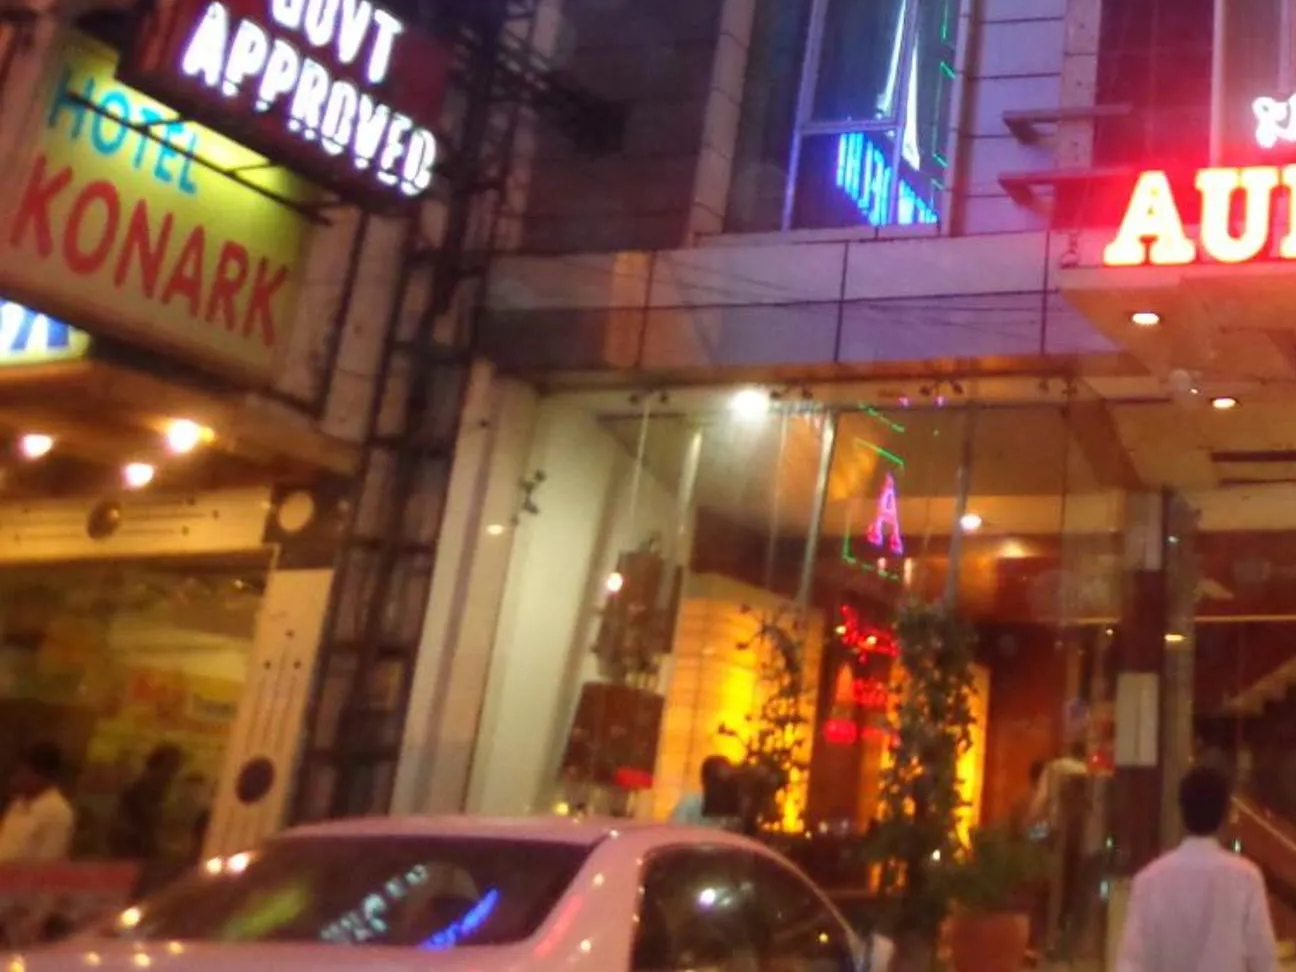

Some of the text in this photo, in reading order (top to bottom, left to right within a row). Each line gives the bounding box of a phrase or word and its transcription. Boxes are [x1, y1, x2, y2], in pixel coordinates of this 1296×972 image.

[47, 61, 198, 196] HOTEL
[181, 1, 437, 196] APPROVED
[9, 155, 291, 348] KONARK
